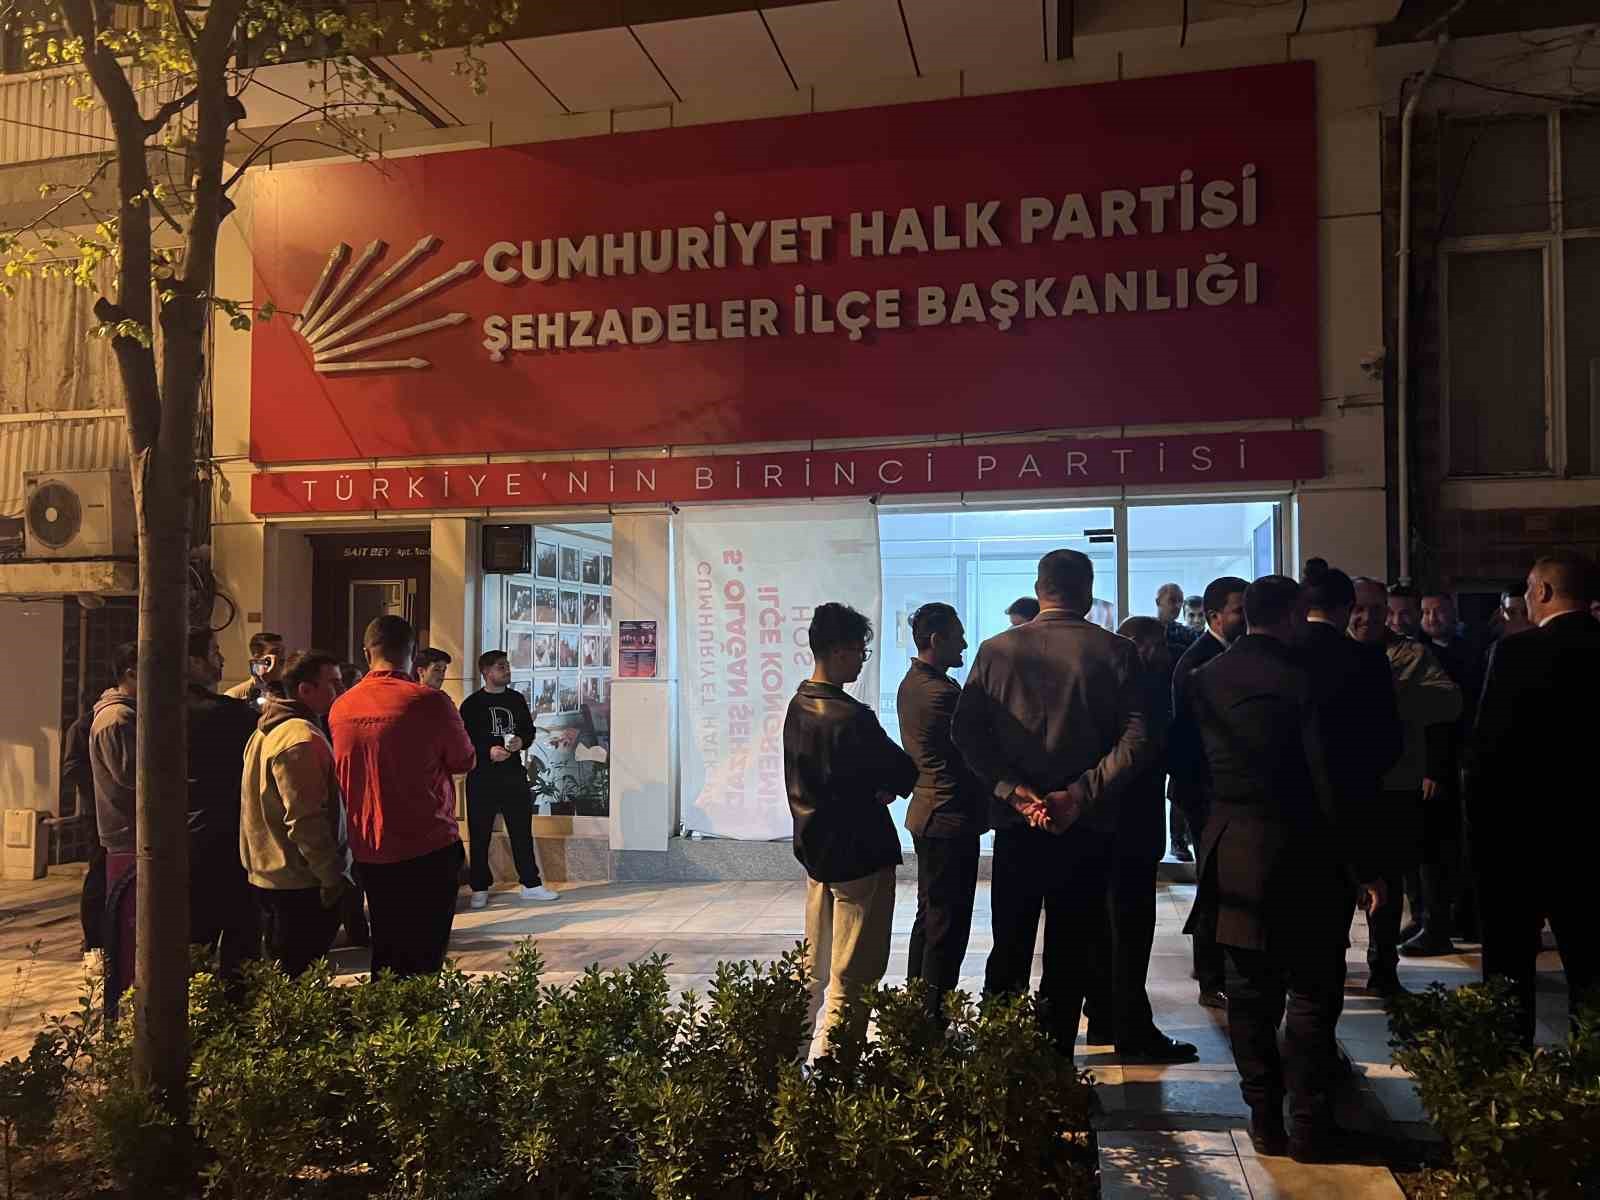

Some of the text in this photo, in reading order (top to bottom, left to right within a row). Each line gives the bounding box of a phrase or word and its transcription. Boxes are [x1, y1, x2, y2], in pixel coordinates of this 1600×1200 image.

[483, 163, 1257, 283] CUMHURİYET HALK PARTİSİ
[483, 252, 1258, 362] ŞEHZADELER İLÇE BAŞKANLIĞI
[301, 437, 1247, 502] TÜRKİYE'NİN BİRİNCİ PARTİSİ
